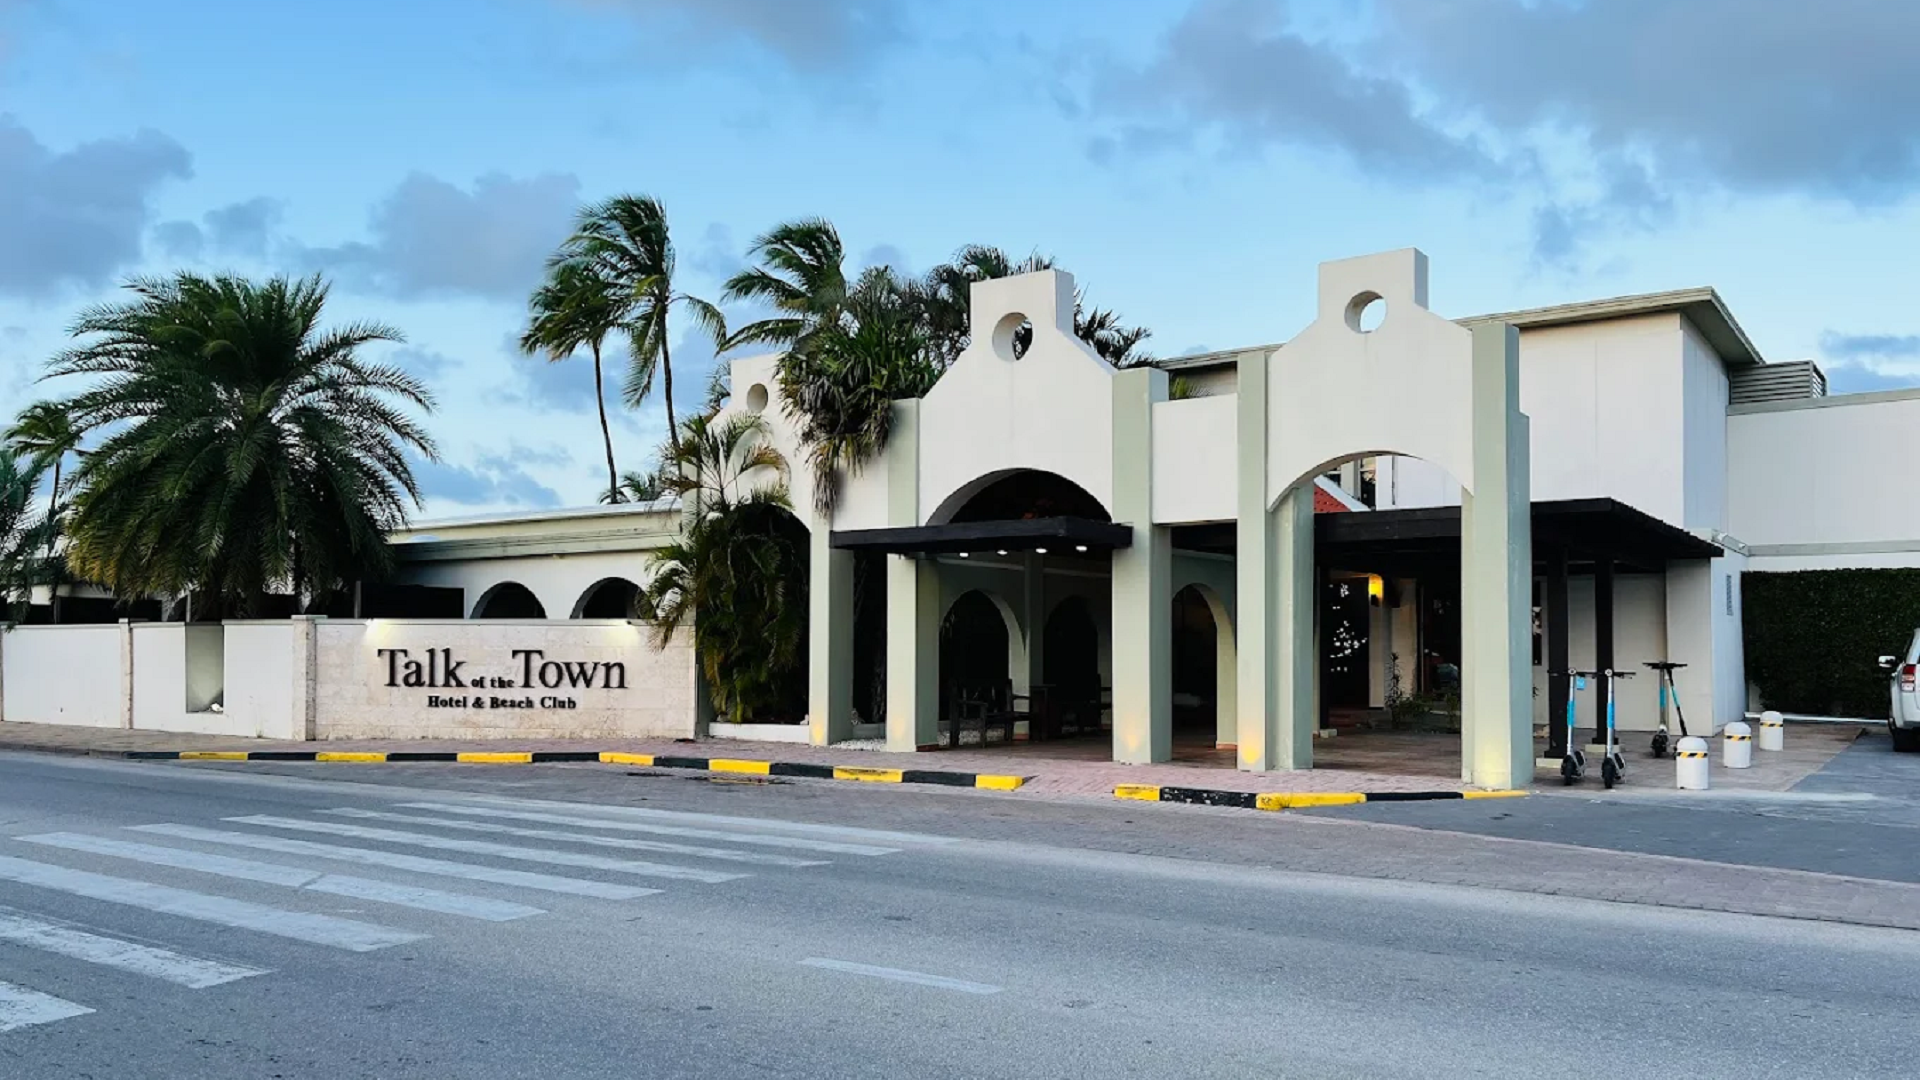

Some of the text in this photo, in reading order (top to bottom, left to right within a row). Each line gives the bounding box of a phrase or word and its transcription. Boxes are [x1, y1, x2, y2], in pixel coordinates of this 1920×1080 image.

[377, 648, 628, 689] Talk of the Town
[427, 695, 577, 709] Hotel & Beach Club
